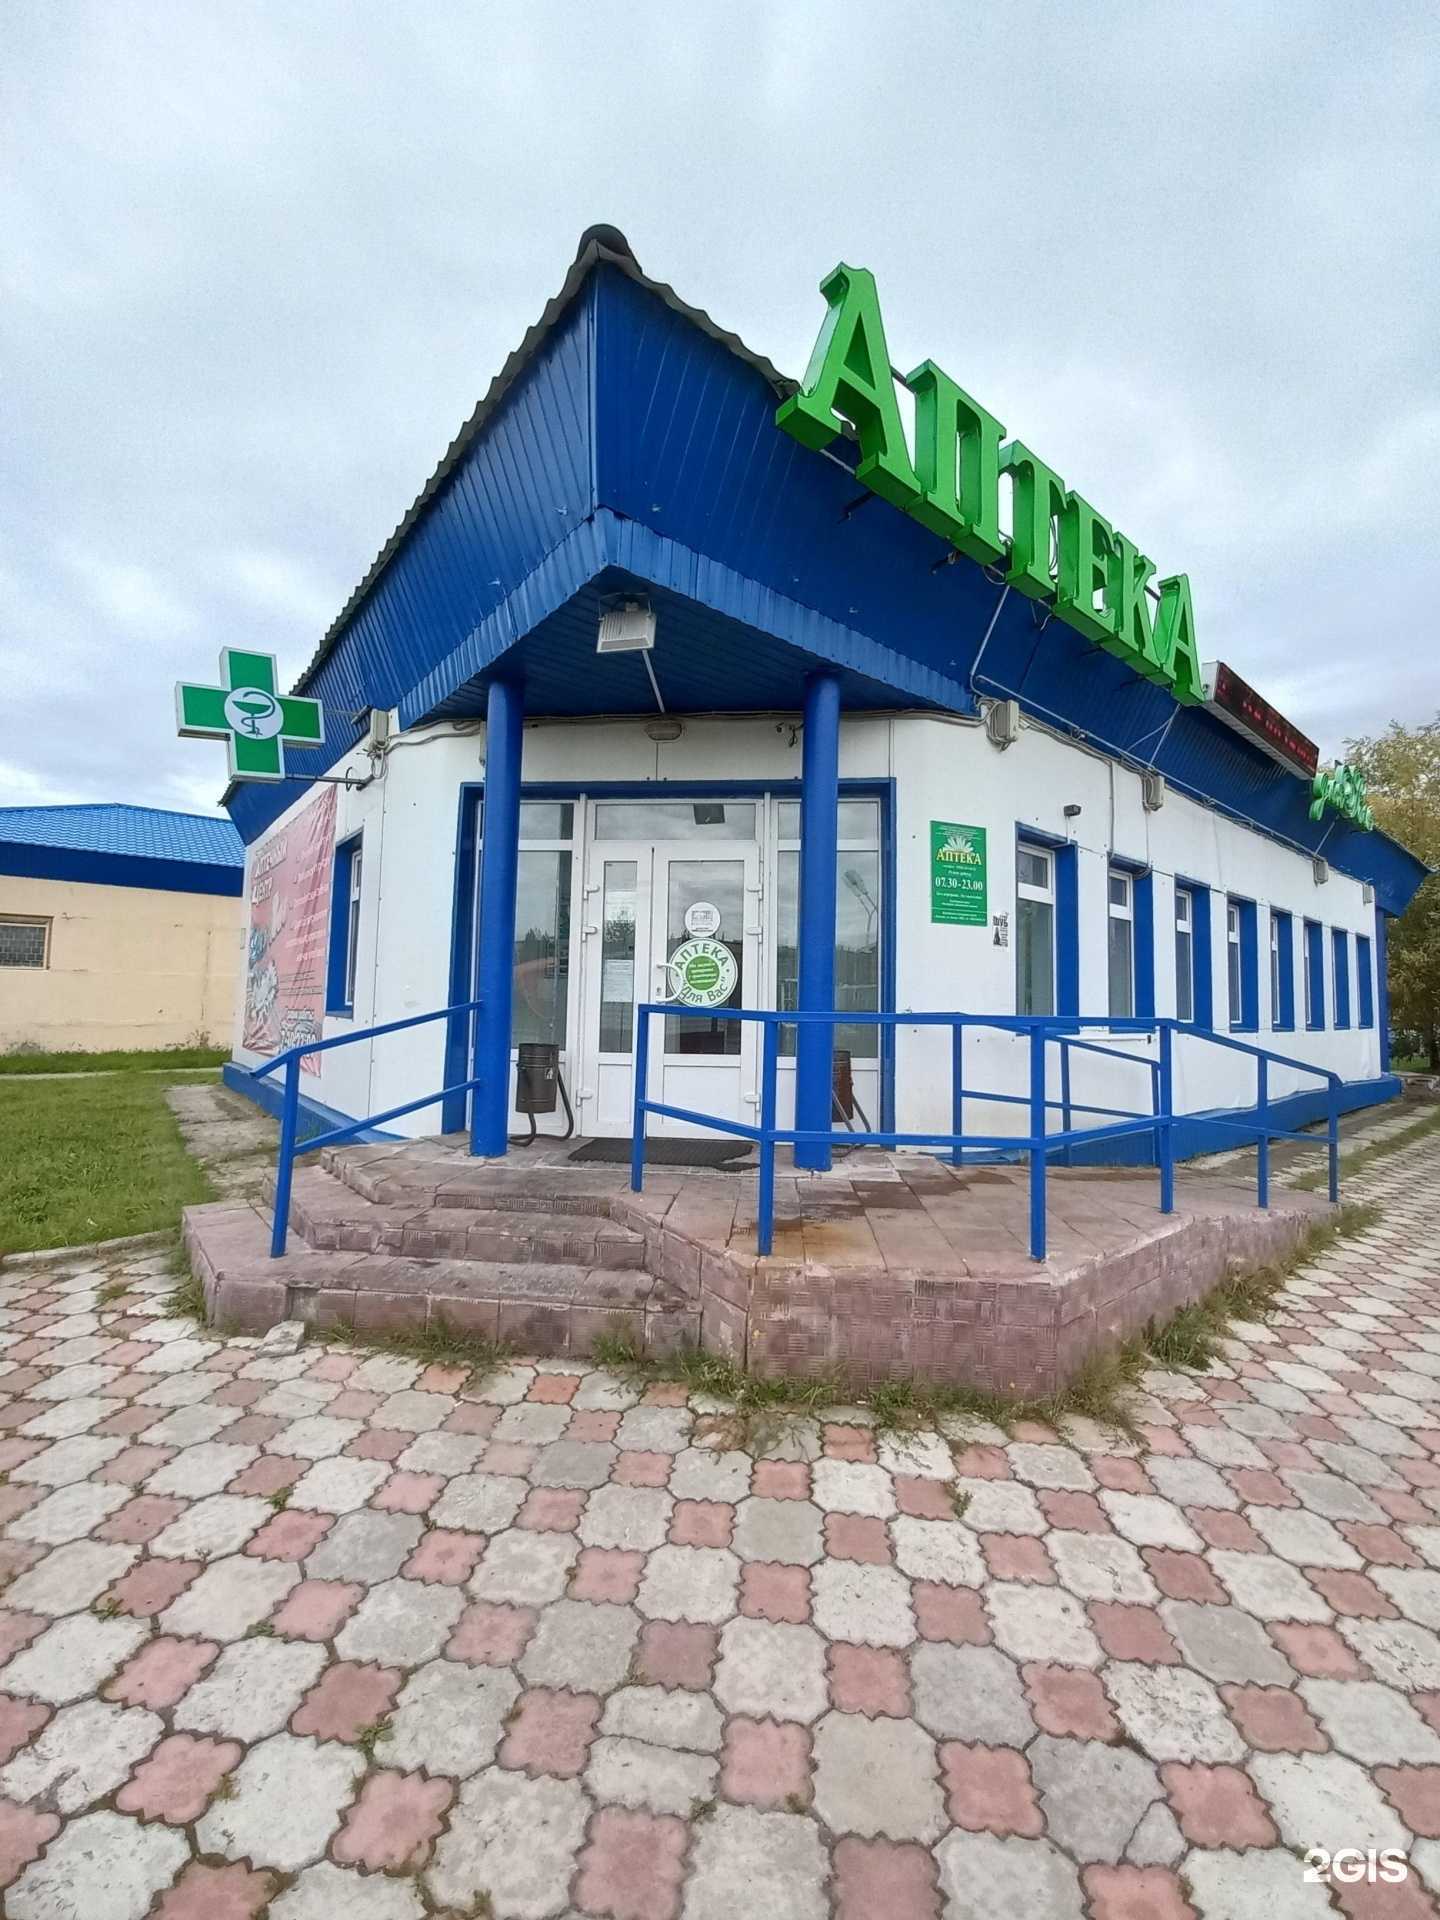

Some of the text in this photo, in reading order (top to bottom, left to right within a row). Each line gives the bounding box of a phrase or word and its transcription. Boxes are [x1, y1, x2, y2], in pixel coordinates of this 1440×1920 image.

[775, 261, 1205, 706] АПТЕКА
[935, 848, 982, 865] АПТЕКА
[674, 943, 729, 971] АПТЕКА
